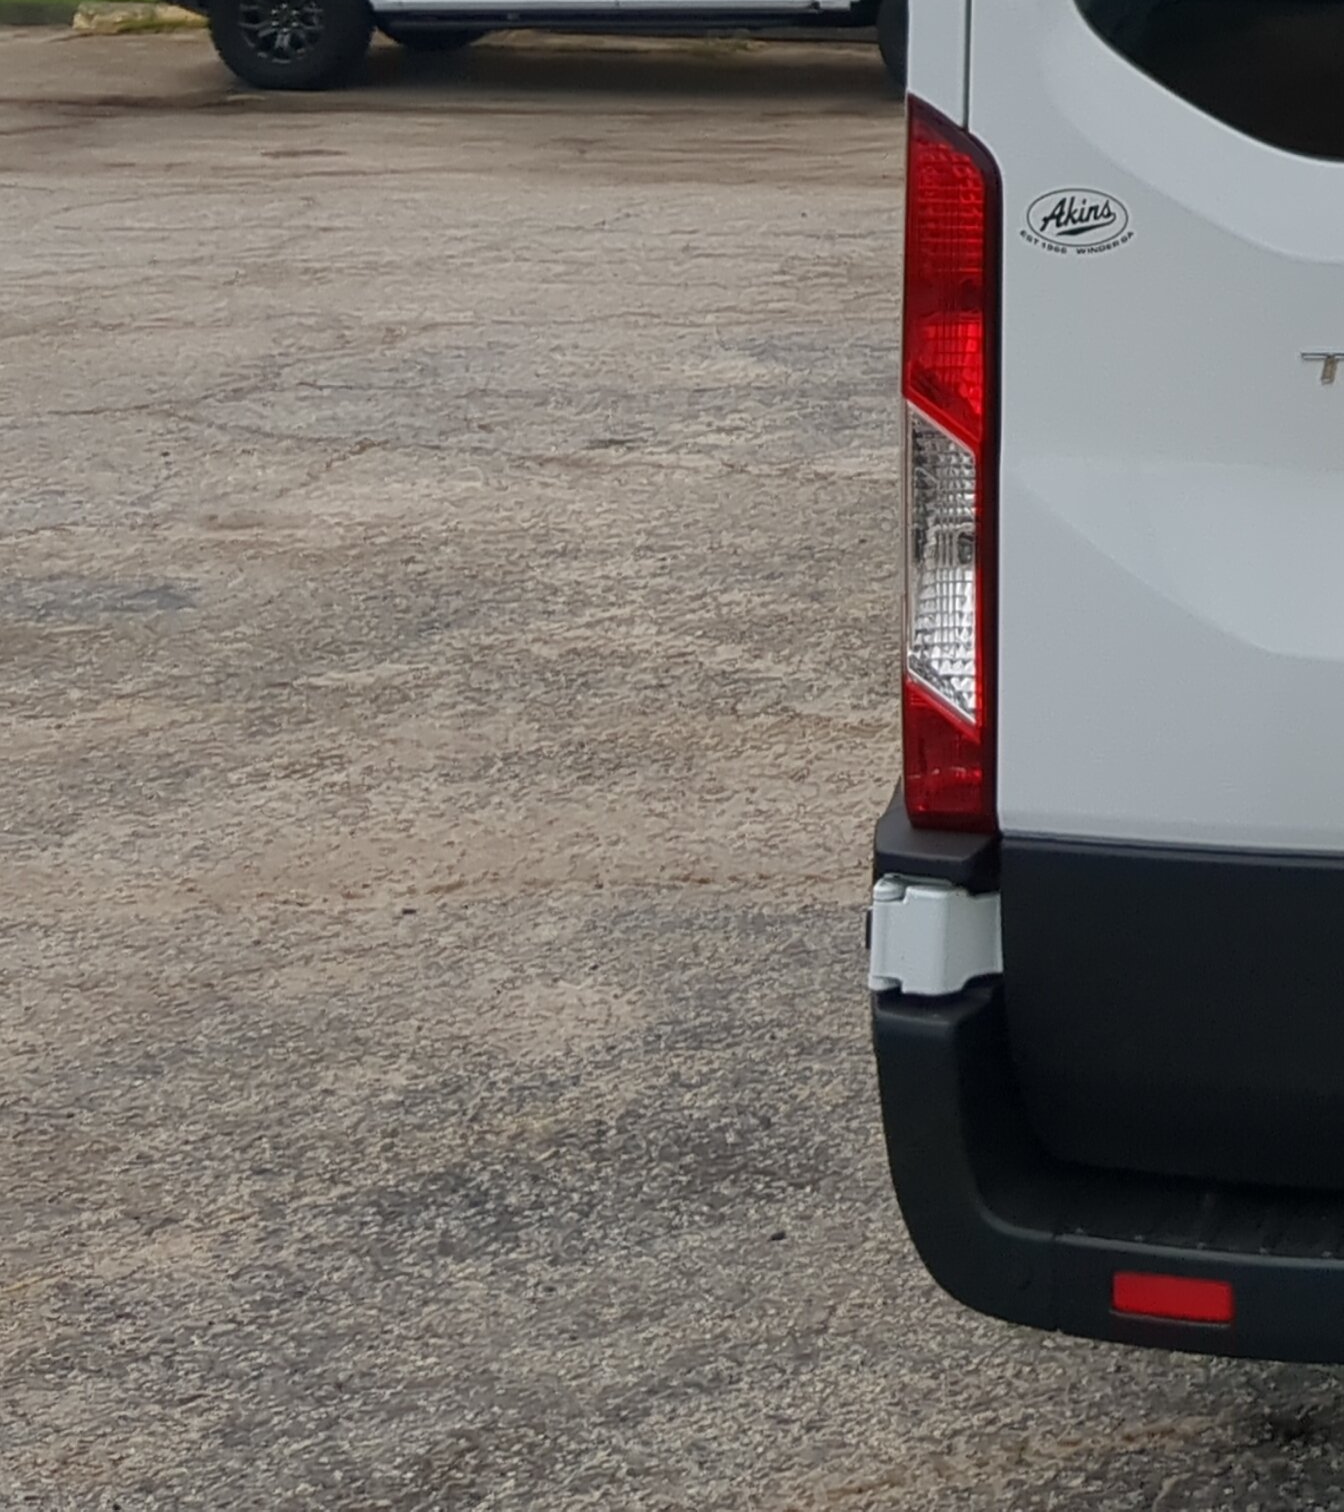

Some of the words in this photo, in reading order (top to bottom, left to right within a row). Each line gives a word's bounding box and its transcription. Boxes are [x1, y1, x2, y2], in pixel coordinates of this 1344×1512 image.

[1039, 196, 1116, 236] Akins
[1019, 229, 1039, 245] EST
[1076, 240, 1120, 255] WINDER
